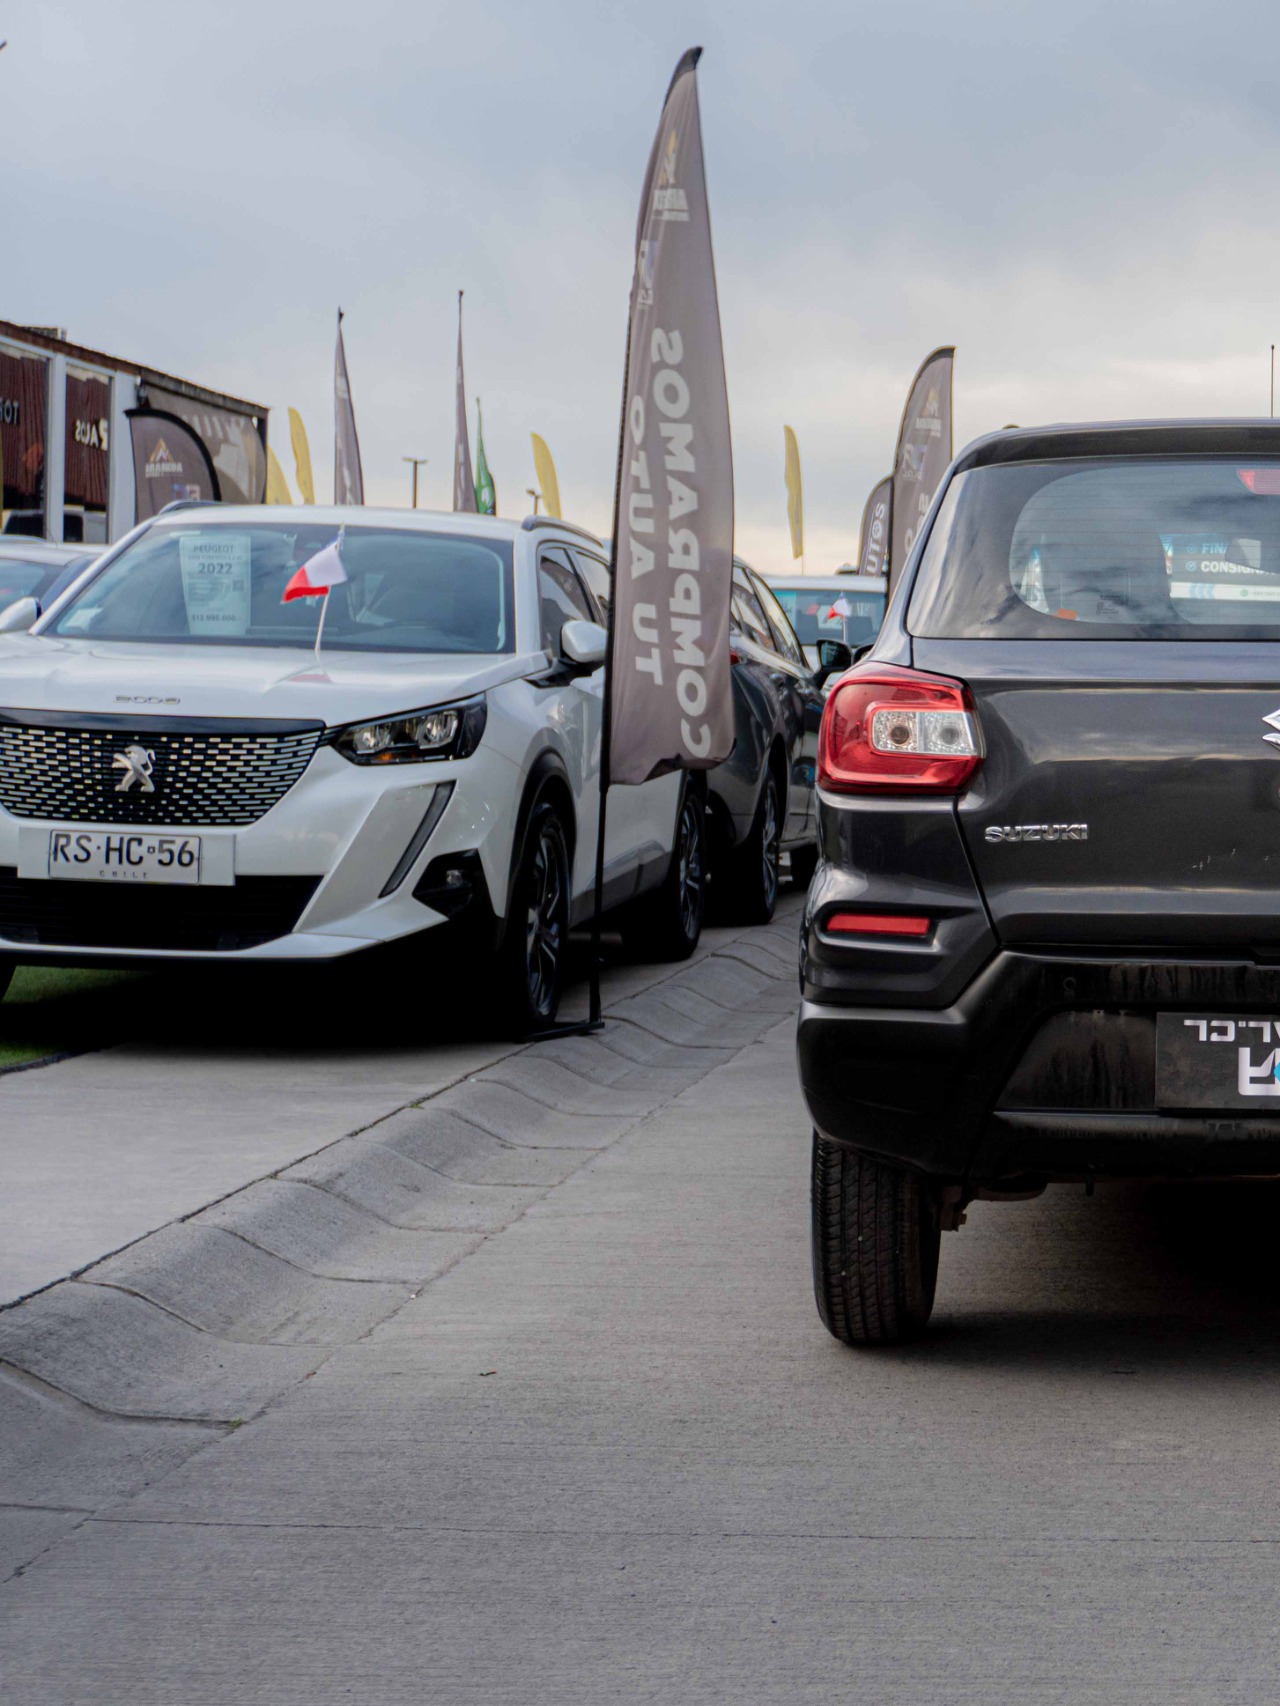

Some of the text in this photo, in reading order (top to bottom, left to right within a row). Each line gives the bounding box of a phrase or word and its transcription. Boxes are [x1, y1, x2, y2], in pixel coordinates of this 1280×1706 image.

[866, 502, 887, 573] UTOS
[193, 545, 234, 553] PEUGEOT
[198, 562, 233, 574] 2022
[985, 824, 1088, 842] SUZUKI
[99, 870, 148, 879] CHILE
